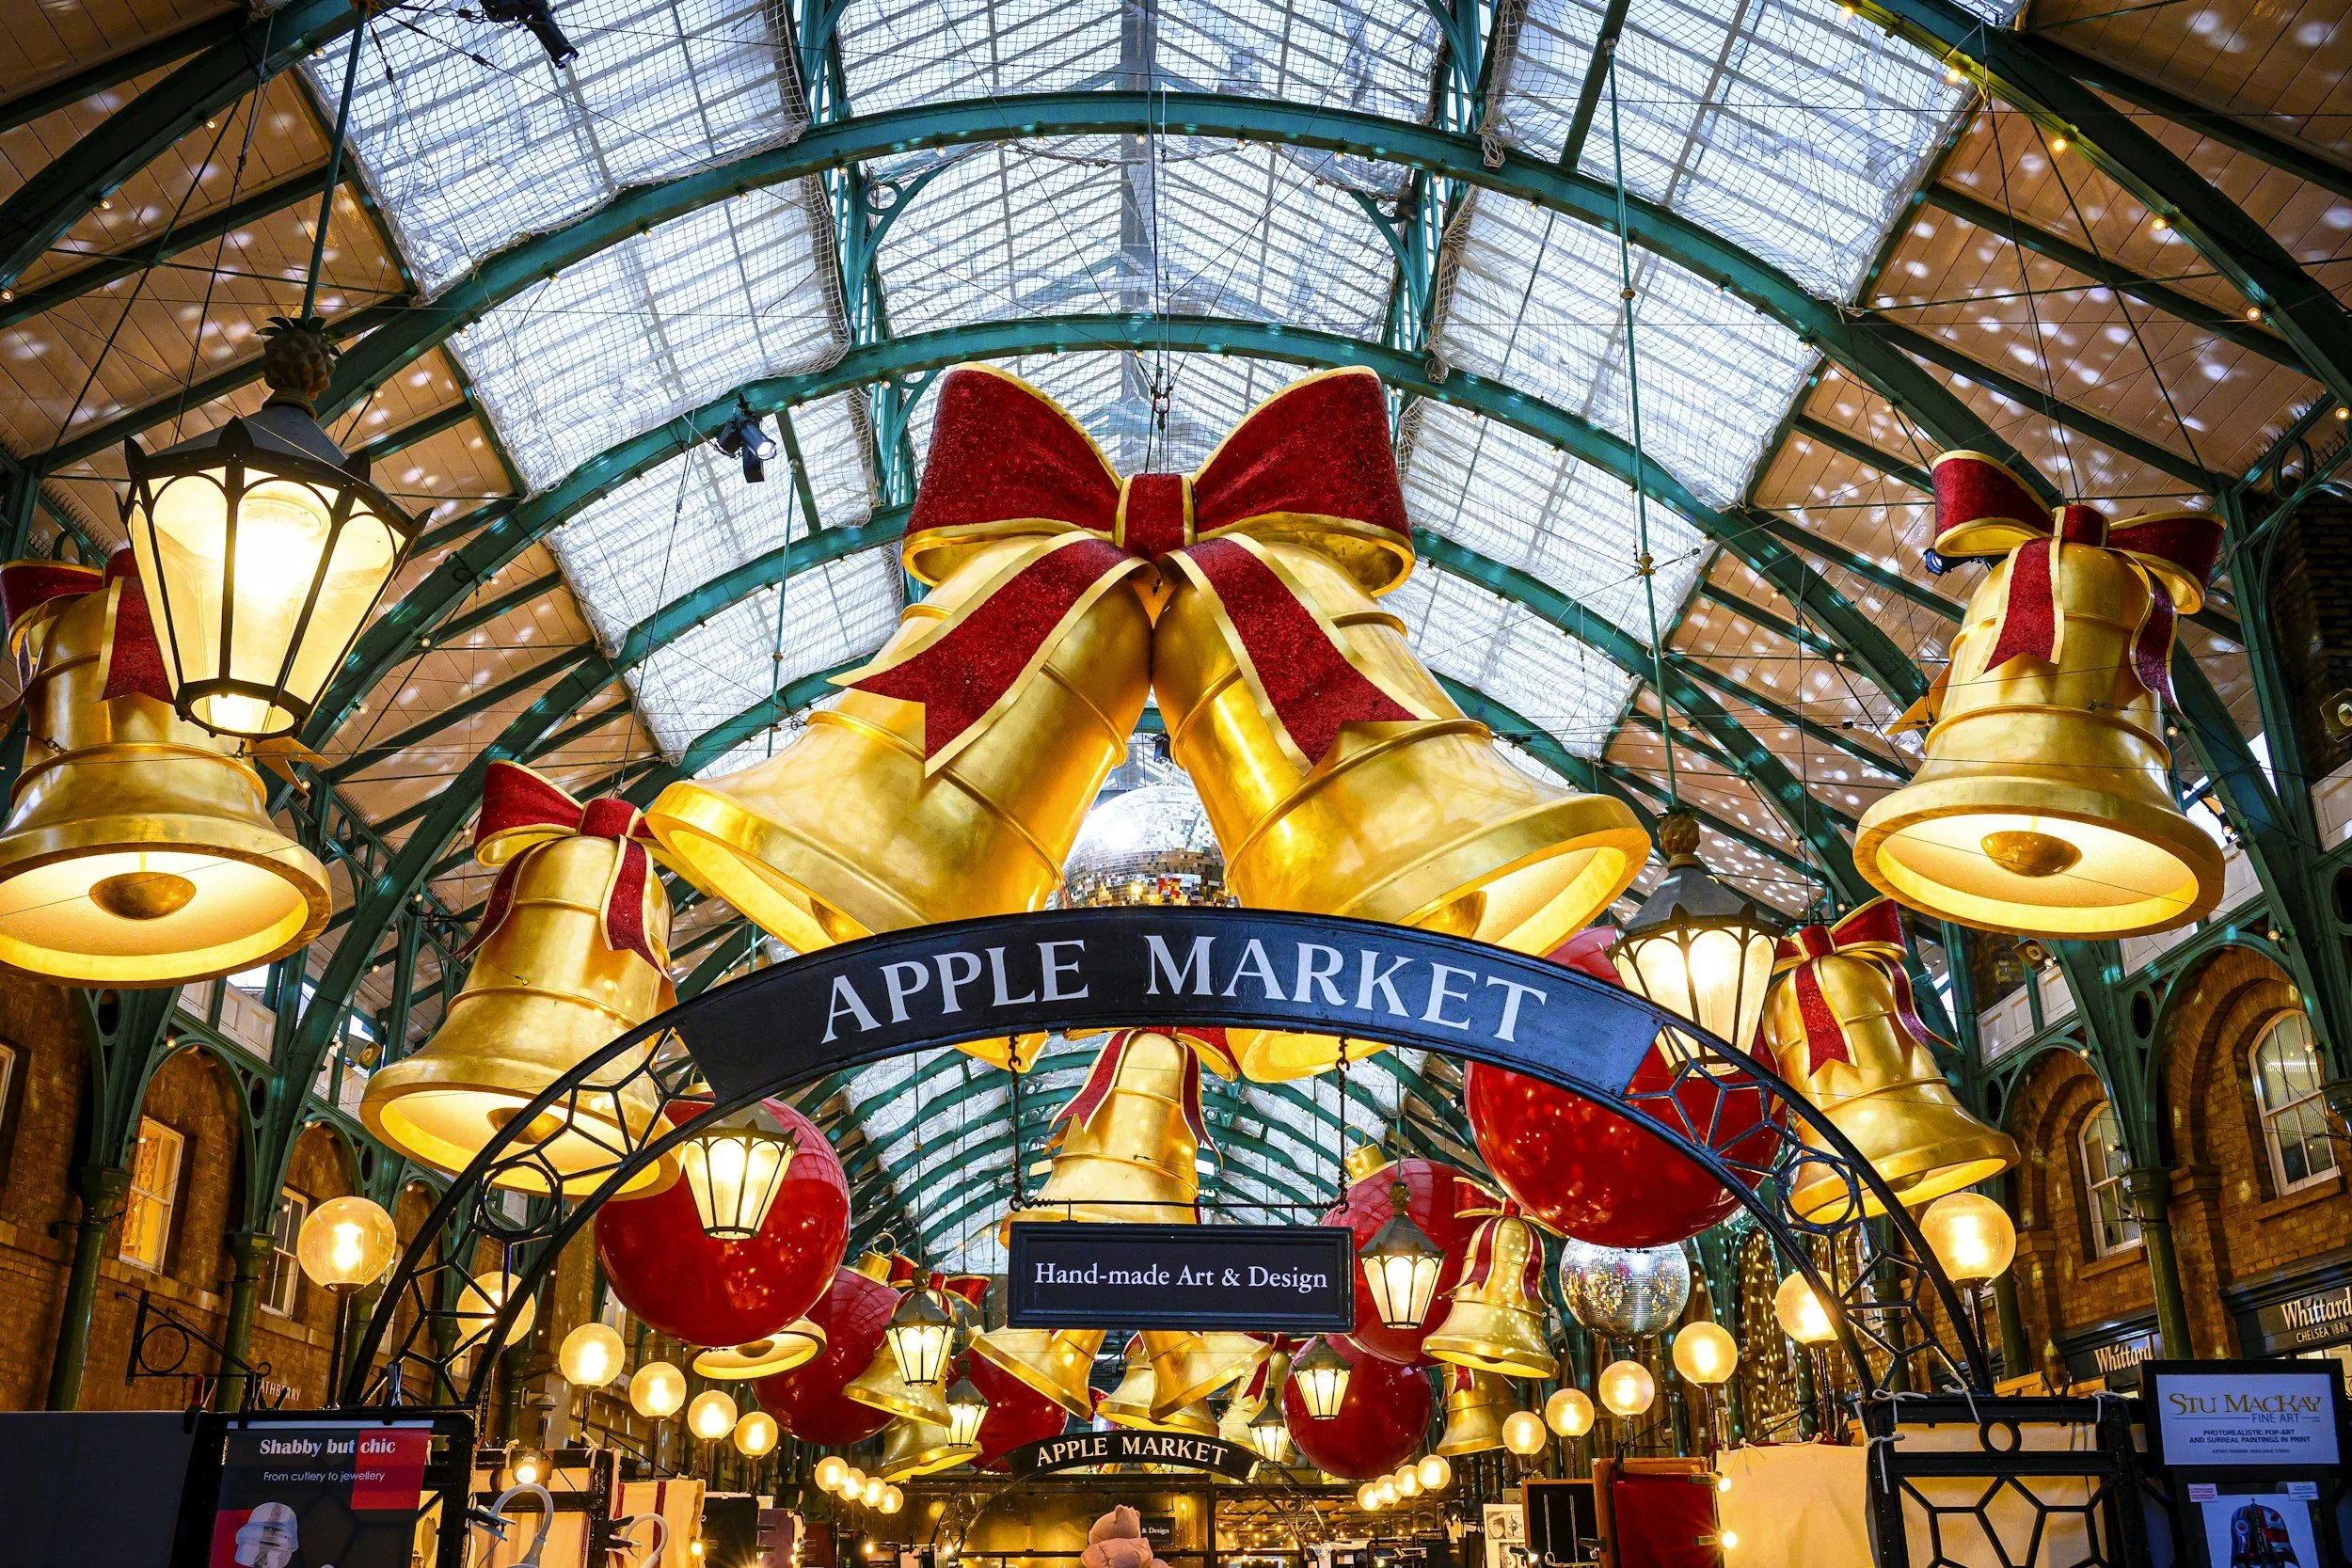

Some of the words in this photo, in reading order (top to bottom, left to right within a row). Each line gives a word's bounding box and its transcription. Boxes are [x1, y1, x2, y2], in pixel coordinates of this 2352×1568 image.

[820, 939, 1089, 1045] APPLE
[1144, 934, 1548, 1043] MARKET
[1035, 1262, 1170, 1287] Hand-made
[1176, 1264, 1215, 1287] Art
[1221, 1268, 1241, 1288] &
[1248, 1265, 1328, 1294] Design
[2280, 1286, 2352, 1330] Whittard
[2296, 1326, 2330, 1343] CHELSEA
[2331, 1322, 2349, 1335] 1886
[2093, 1335, 2153, 1373] Whittard
[2251, 1413, 2277, 1423] FINE
[2280, 1413, 2301, 1423] ART
[260, 1438, 322, 1457] Shabby
[326, 1438, 356, 1454] but
[359, 1438, 396, 1454] chic
[1037, 1437, 1108, 1467] APPLE
[1122, 1436, 1229, 1465] MARKET
[263, 1471, 289, 1481] From
[292, 1471, 326, 1482] cutlery
[328, 1471, 339, 1481] to
[340, 1470, 385, 1482] jewellery
[1149, 1527, 1169, 1535] Design
